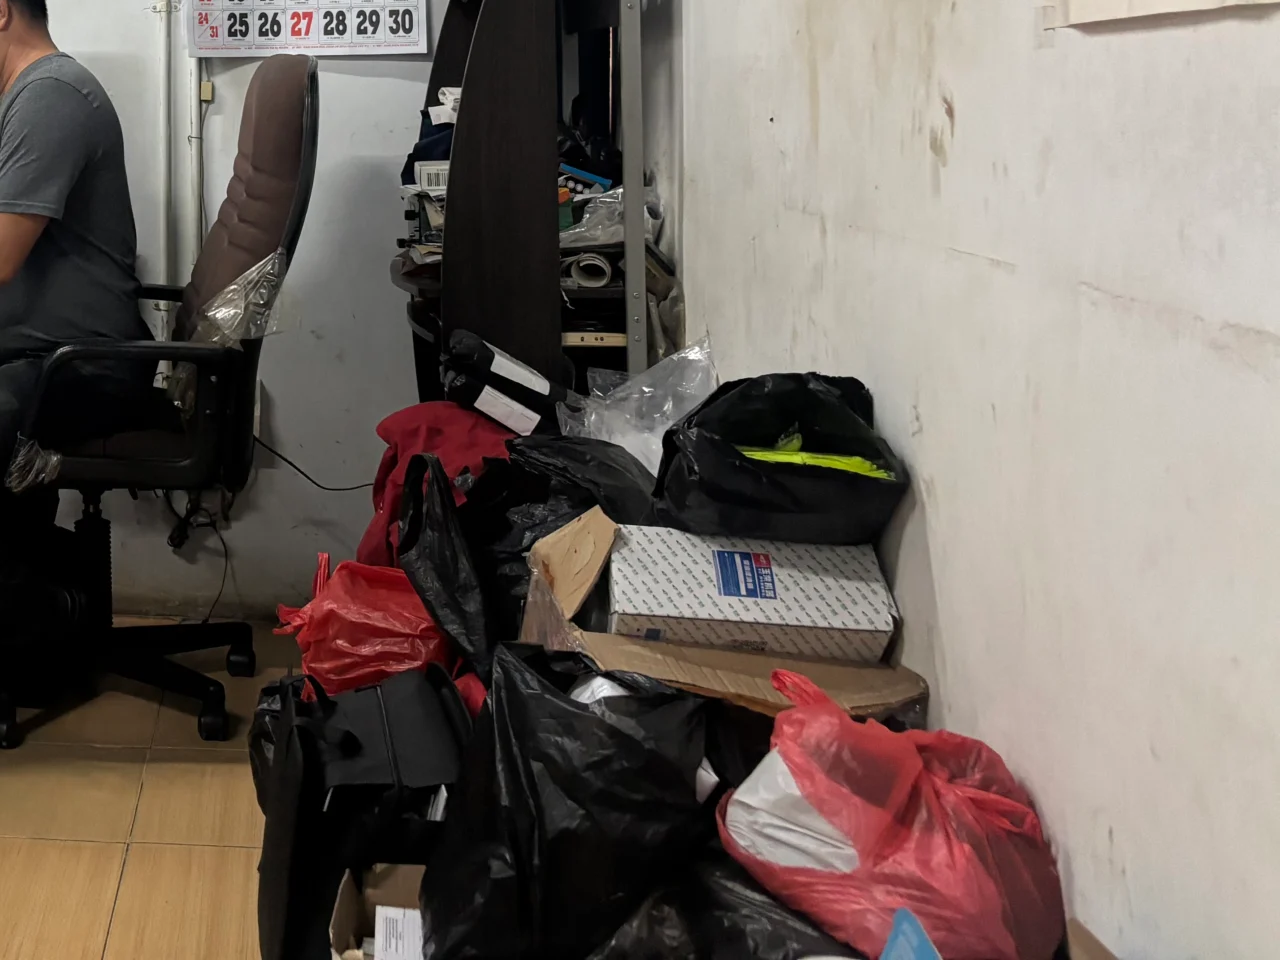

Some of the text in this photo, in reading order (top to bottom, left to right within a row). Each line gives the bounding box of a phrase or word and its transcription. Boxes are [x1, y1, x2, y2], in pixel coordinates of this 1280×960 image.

[197, 8, 414, 38] 24 25 26 27 28 29 30
[209, 25, 219, 38] 31
